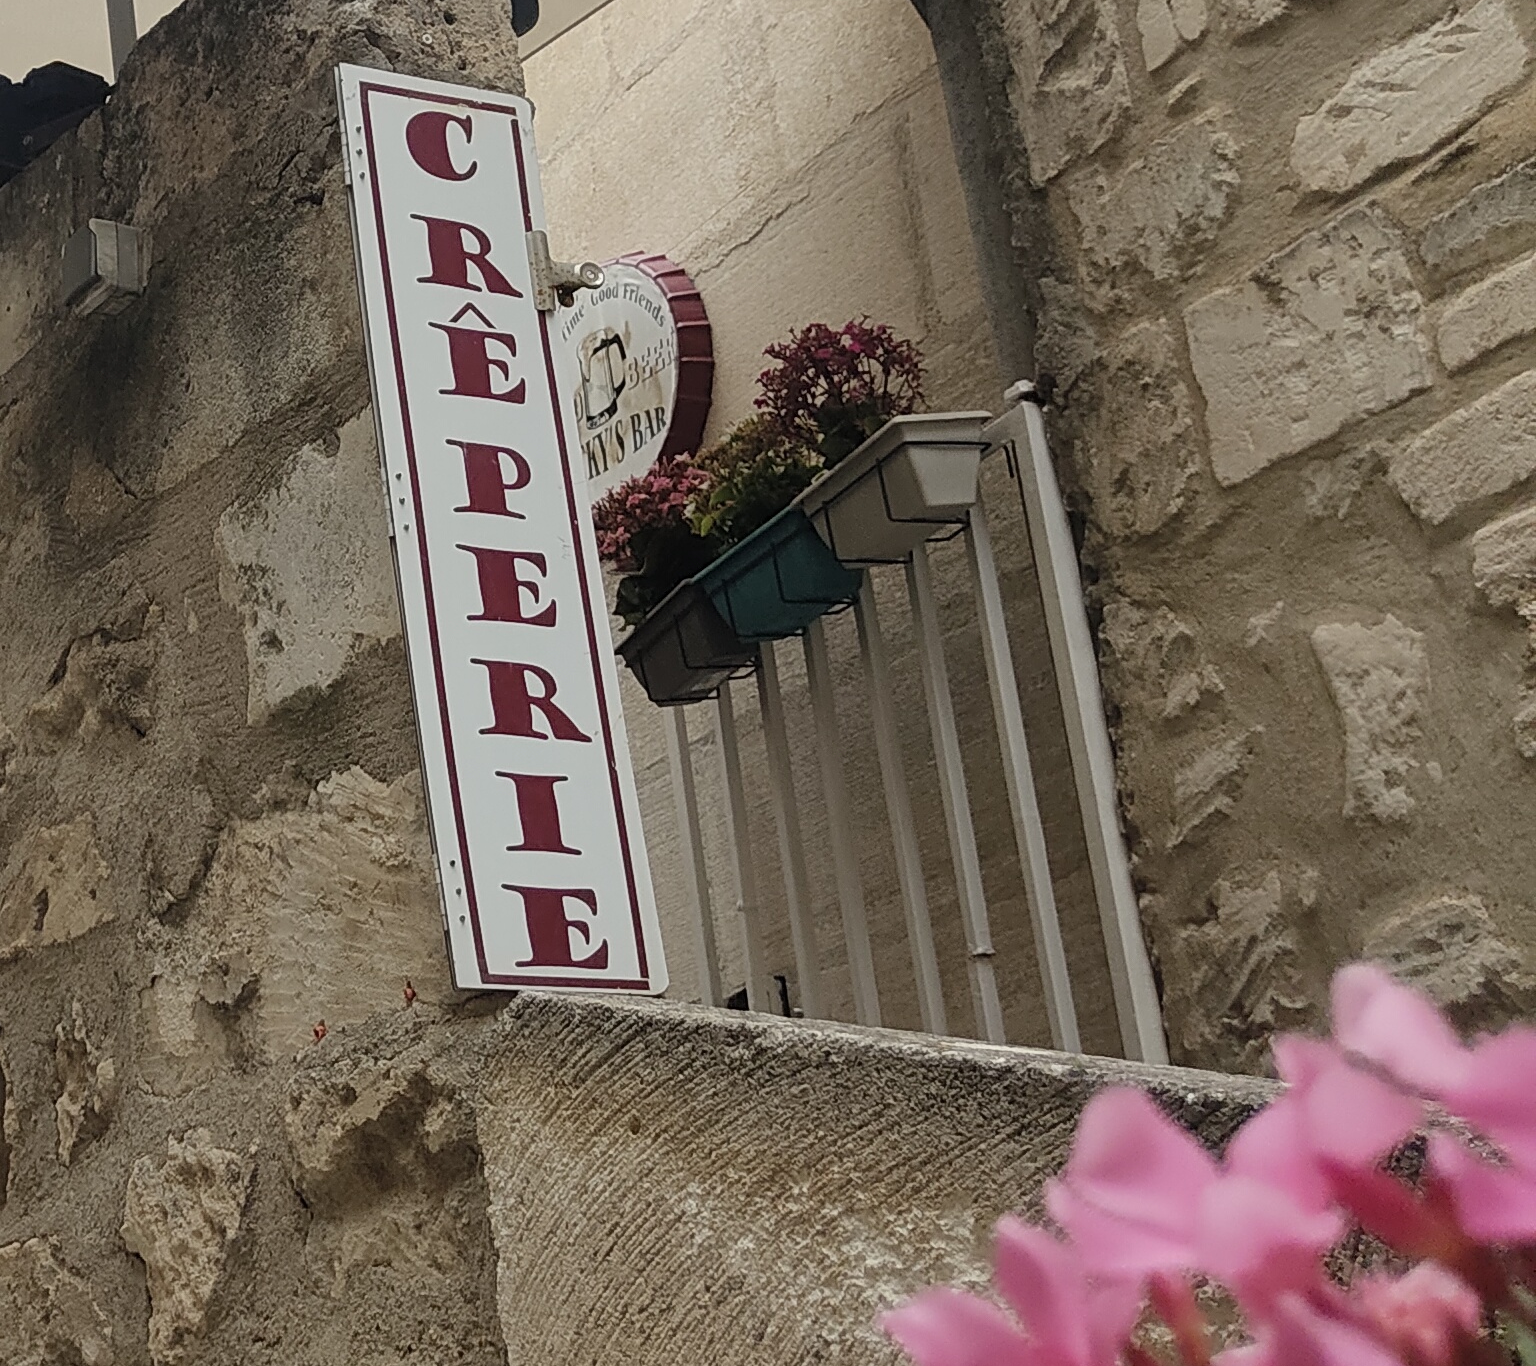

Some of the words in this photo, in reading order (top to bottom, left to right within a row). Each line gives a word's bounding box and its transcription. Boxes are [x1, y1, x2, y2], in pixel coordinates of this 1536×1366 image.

[590, 281, 619, 307] Good
[622, 282, 667, 329] Friends
[629, 406, 667, 454] BAR
[404, 109, 609, 973] CRÊPERIE
